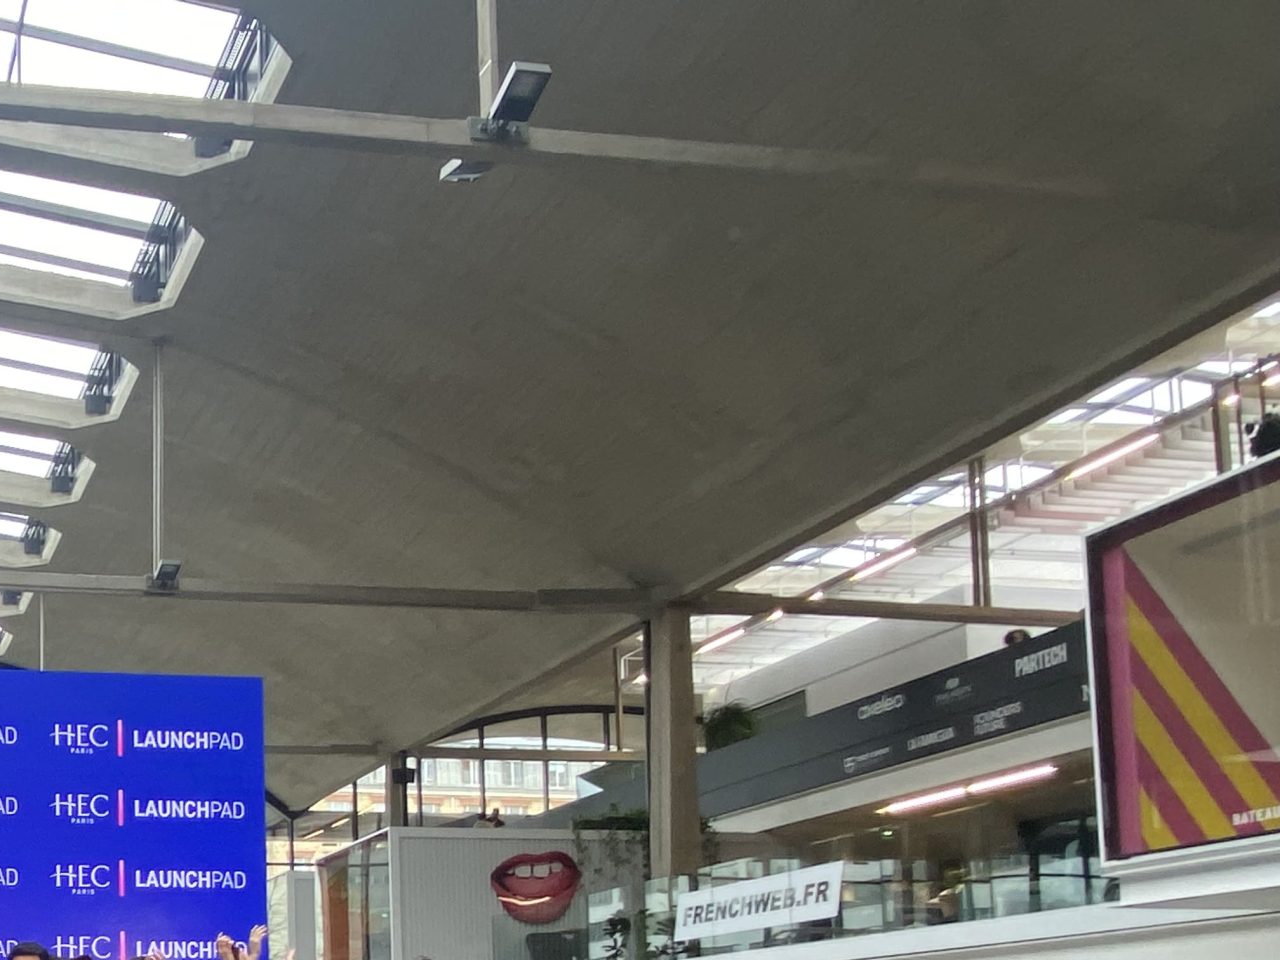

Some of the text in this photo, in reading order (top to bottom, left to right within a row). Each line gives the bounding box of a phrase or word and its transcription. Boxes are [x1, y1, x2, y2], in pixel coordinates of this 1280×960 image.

[1015, 642, 1067, 677] PARTECH
[50, 723, 244, 751] HEC LAUNCHPAD
[50, 794, 245, 820] HEC LAUNCHPAD
[50, 864, 247, 889] HEC LAUNCHPAD
[683, 881, 830, 927] FRENCHWEB.FR
[136, 940, 247, 959] LAUNCH
